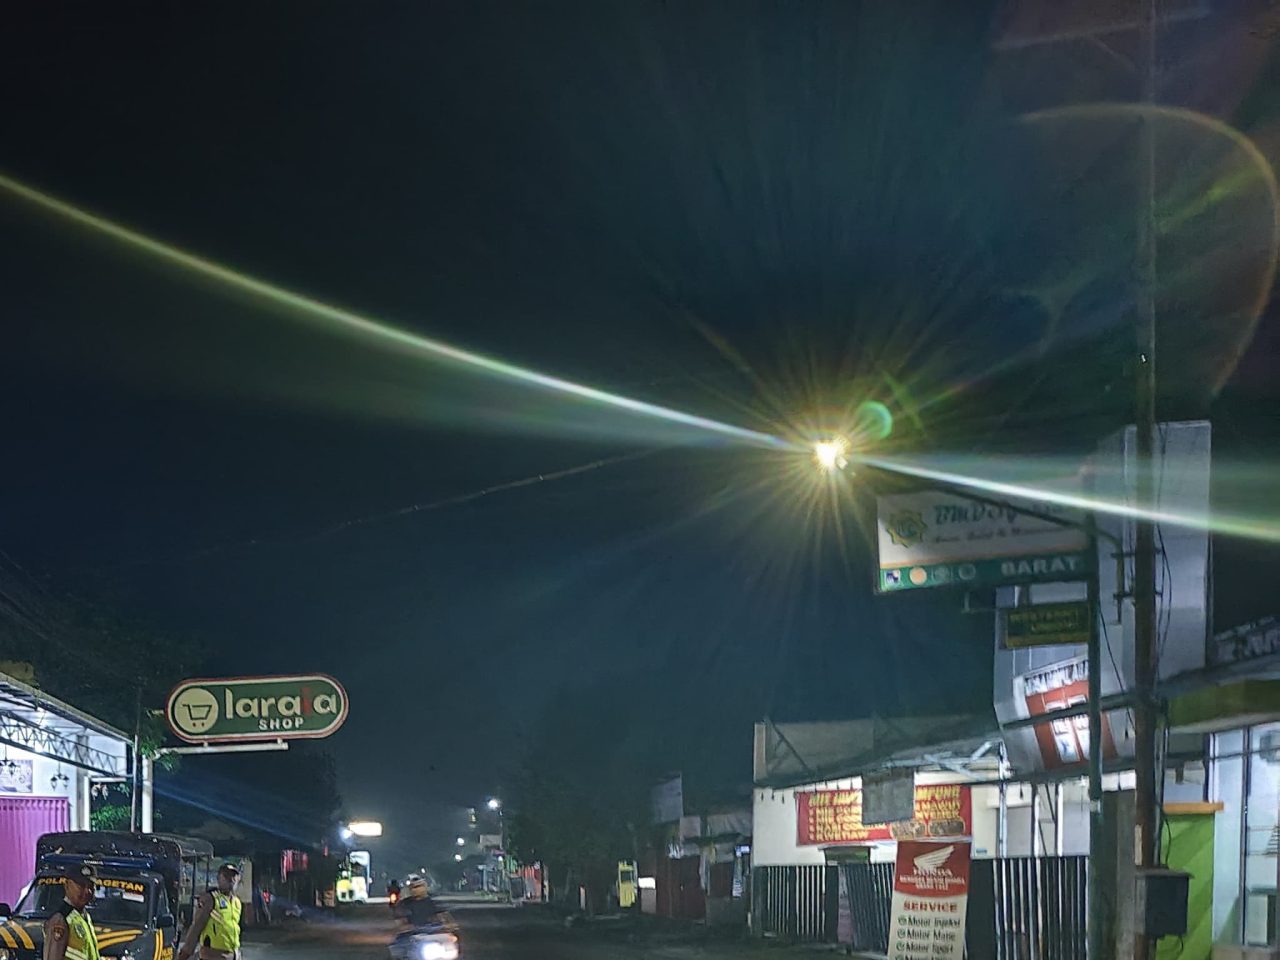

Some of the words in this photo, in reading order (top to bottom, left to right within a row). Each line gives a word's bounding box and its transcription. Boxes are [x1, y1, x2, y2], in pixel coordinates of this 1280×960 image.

[1001, 556, 1078, 576] BARAT
[258, 717, 304, 731] SHOP
[94, 878, 144, 892] AGETAN
[903, 901, 958, 913] SERVICE
